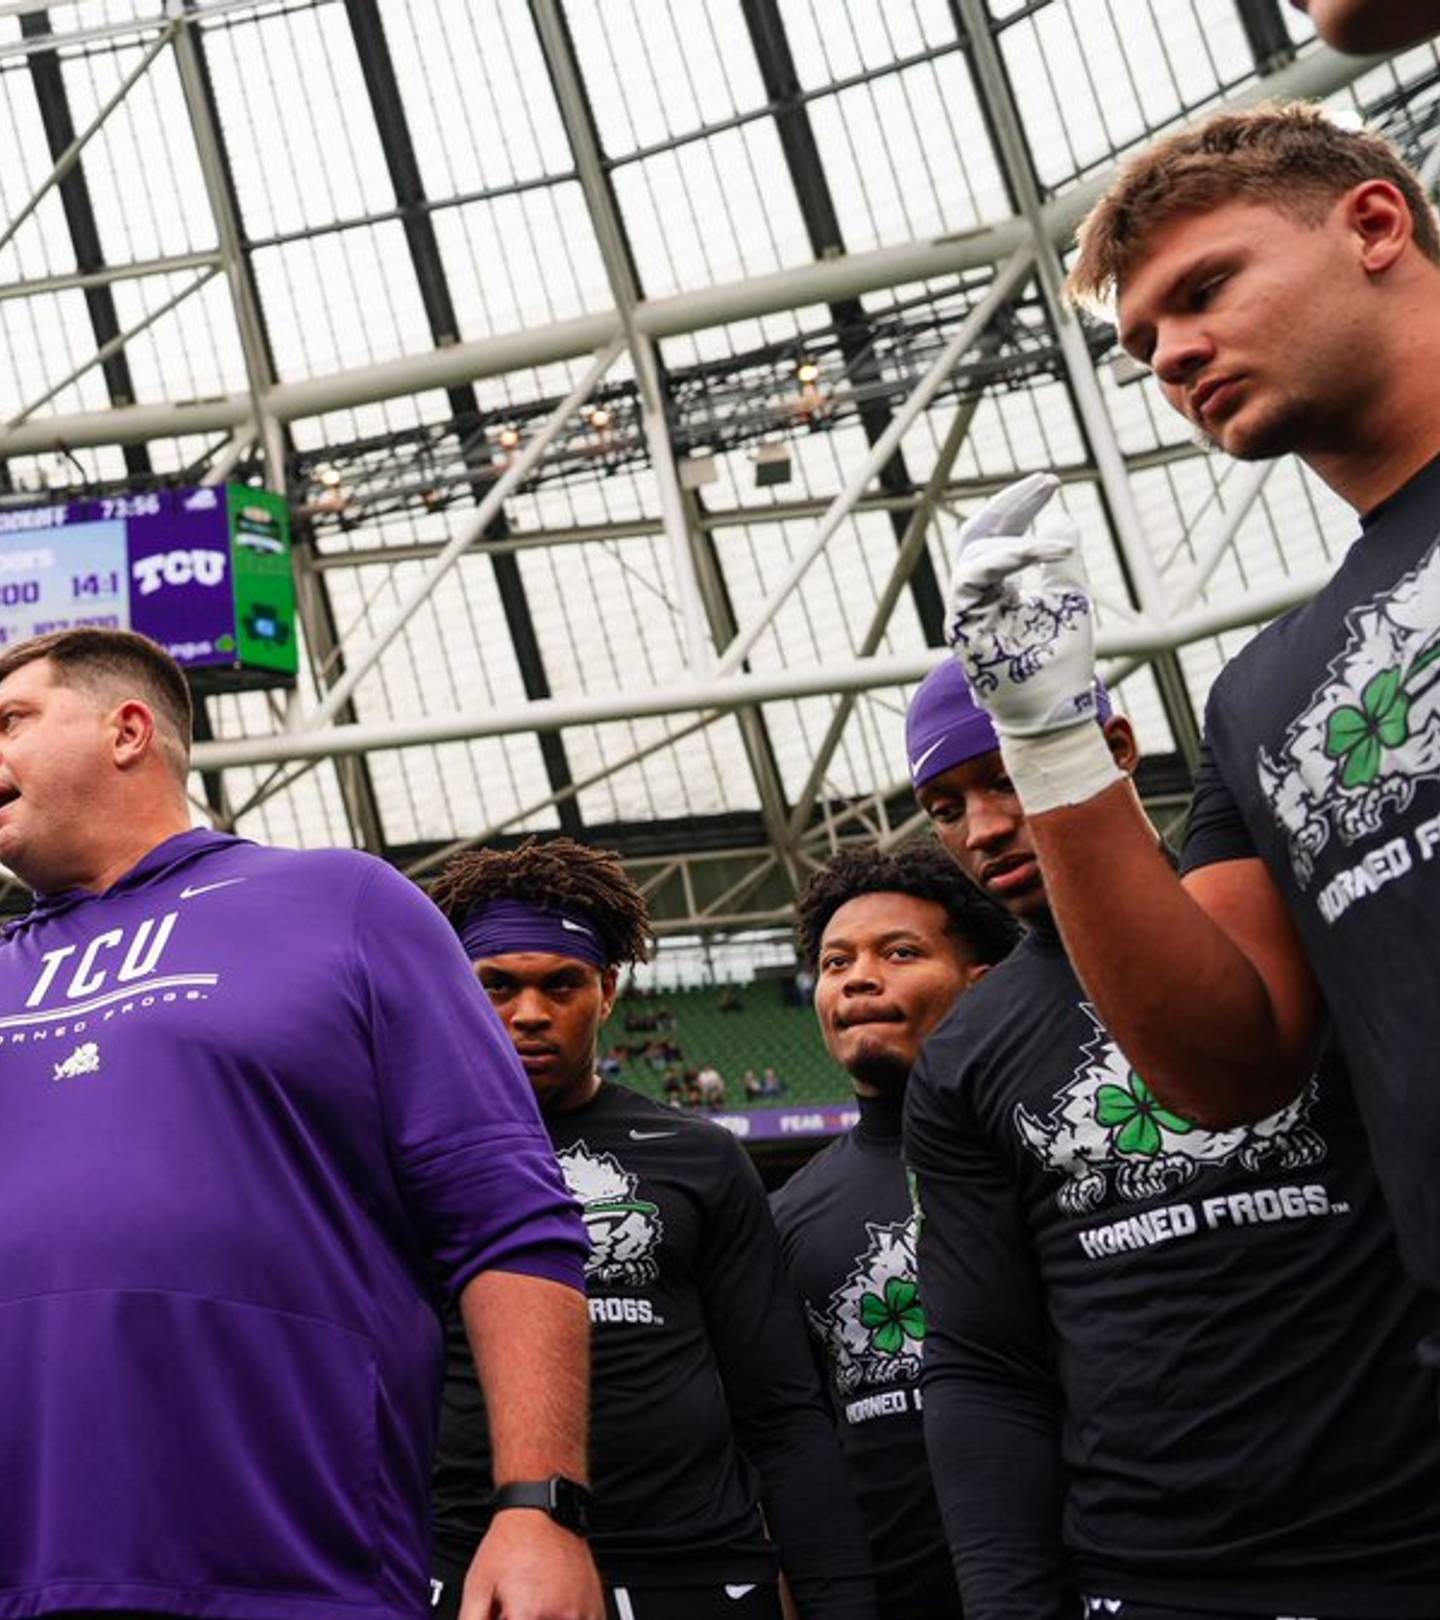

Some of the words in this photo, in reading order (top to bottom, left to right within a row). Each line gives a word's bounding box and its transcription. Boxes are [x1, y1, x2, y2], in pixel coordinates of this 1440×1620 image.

[133, 550, 226, 596] TCU
[25, 912, 179, 1007] TCU
[1079, 1203, 1198, 1259] HORNED
[588, 1297, 653, 1323] ROGS
